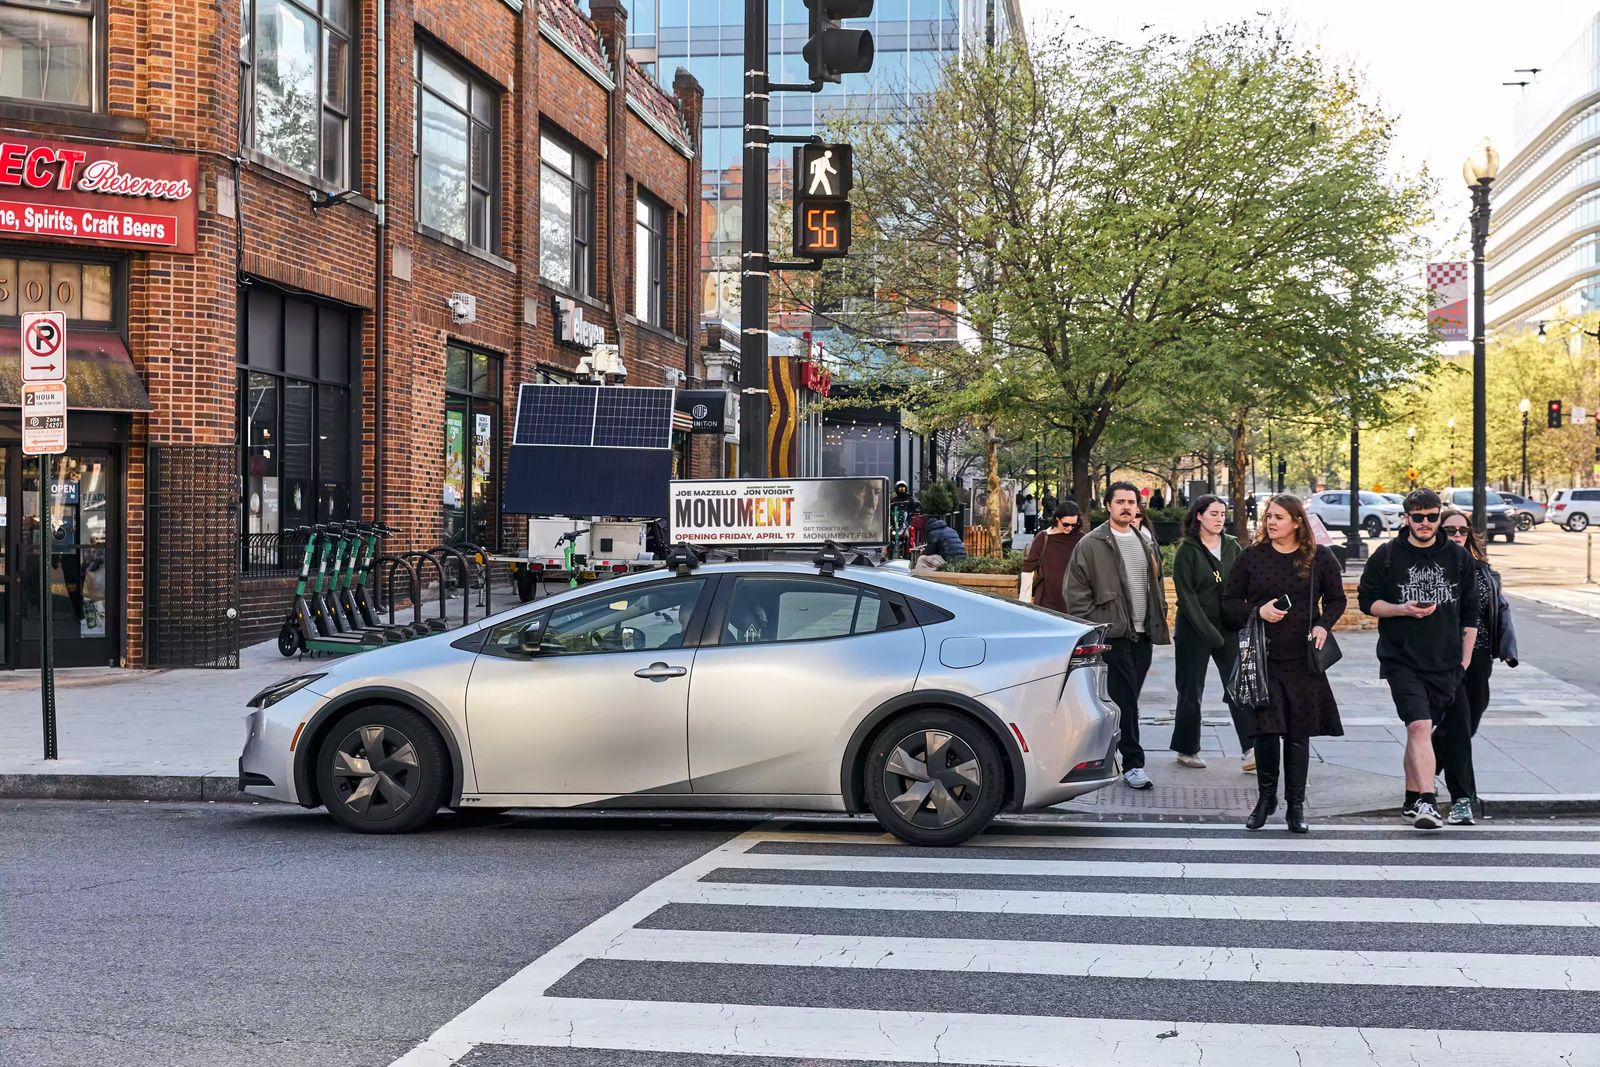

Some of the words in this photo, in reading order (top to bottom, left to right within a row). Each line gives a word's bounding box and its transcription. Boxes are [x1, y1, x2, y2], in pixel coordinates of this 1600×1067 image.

[0, 143, 86, 190] ECT
[78, 160, 192, 200] Reserves
[24, 207, 78, 235] Spirits,
[82, 213, 119, 234] Craft
[124, 216, 164, 238] Beers
[808, 210, 838, 248] 56
[27, 394, 33, 404] 2
[51, 484, 76, 493] OPEN
[676, 497, 794, 528] MONUMENT
[1421, 582, 1434, 590] THE
